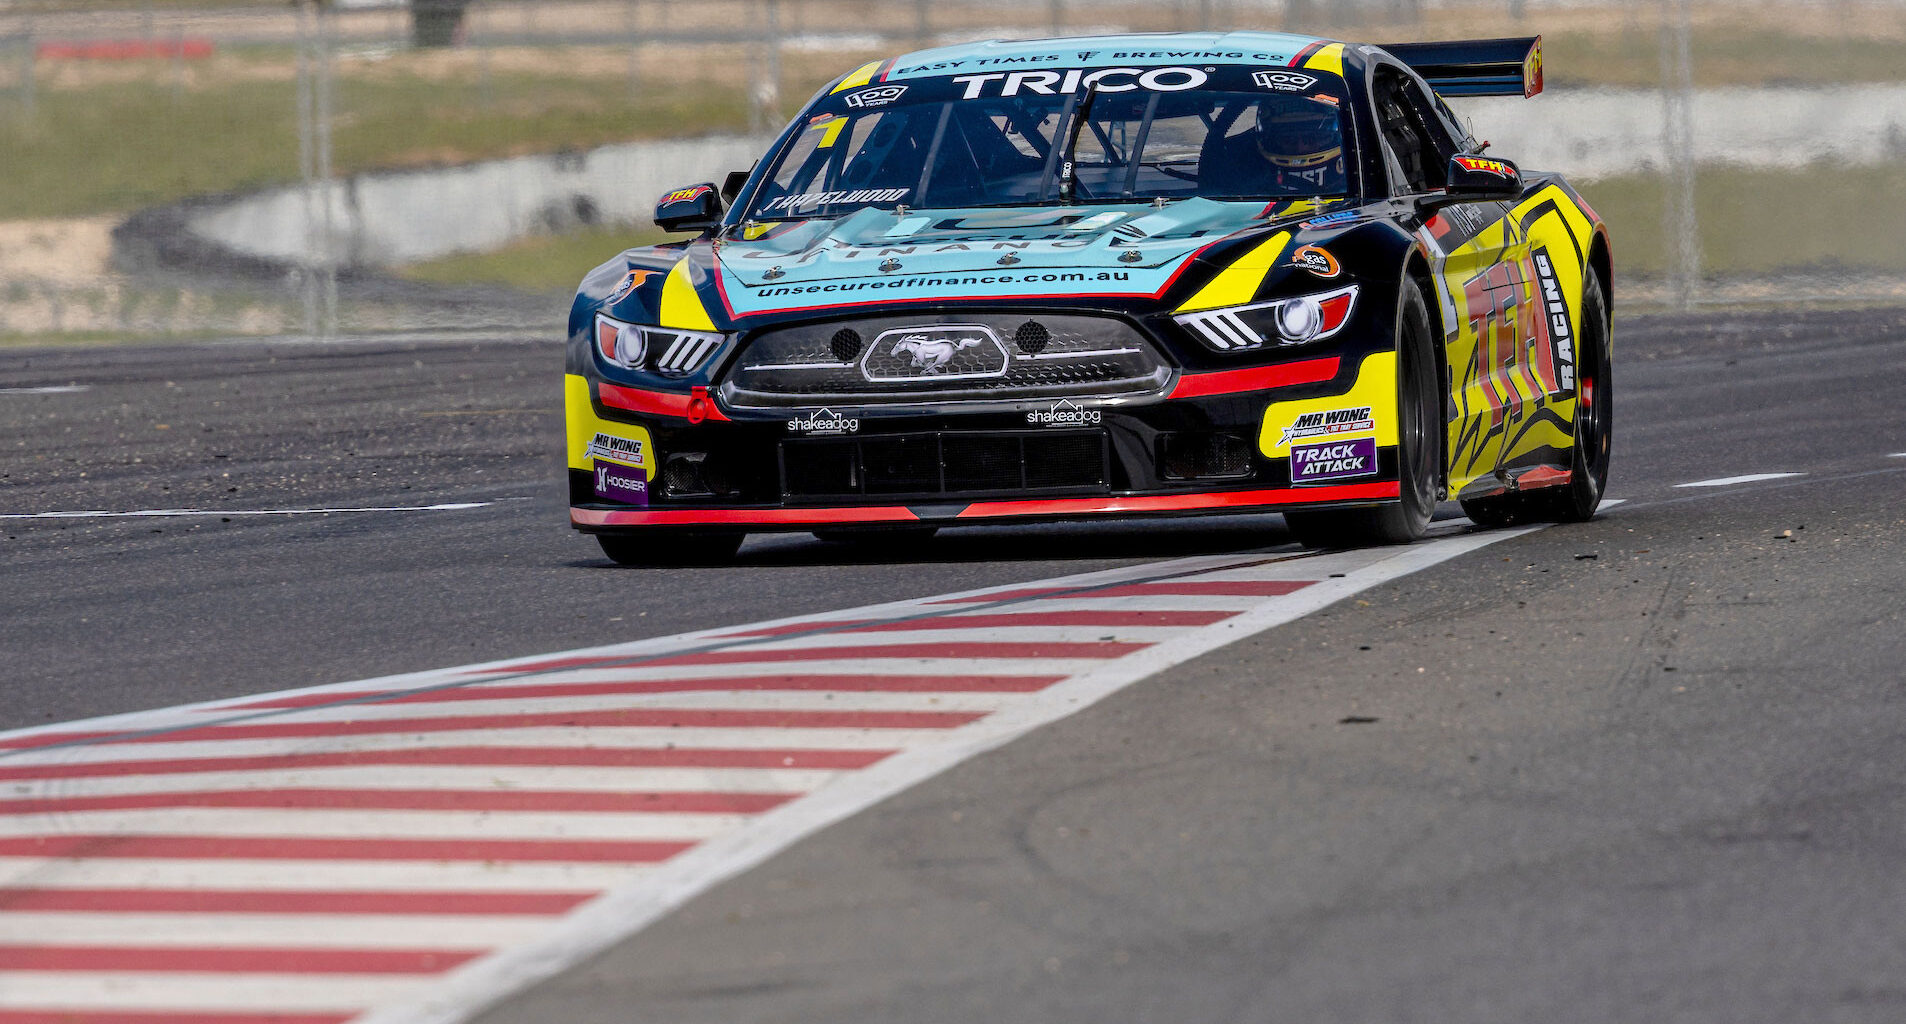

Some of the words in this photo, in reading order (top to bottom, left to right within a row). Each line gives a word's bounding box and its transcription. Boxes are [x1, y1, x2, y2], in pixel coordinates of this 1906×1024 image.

[897, 61, 967, 76] EASY
[976, 54, 1060, 66] TIMES
[1112, 51, 1244, 59] BREWING
[952, 69, 1208, 99] TRICO
[1260, 73, 1308, 89] 100
[851, 88, 899, 107] 100
[811, 117, 849, 149] 1
[1465, 159, 1504, 172] TFH
[669, 189, 697, 201] TFH
[1304, 255, 1327, 265] gas
[757, 271, 1130, 298] unsecuredfinance.com.au
[1535, 254, 1575, 391] RACING
[787, 412, 858, 432] shakeadog
[1027, 404, 1101, 424] shakeadog
[1296, 413, 1324, 428] MR
[1325, 407, 1371, 425] WONG
[594, 433, 610, 448] MR
[610, 436, 642, 454] WONG
[1295, 443, 1356, 464] TRACK
[1301, 456, 1365, 476] ATTACK
[607, 475, 645, 493] HOOSIER
